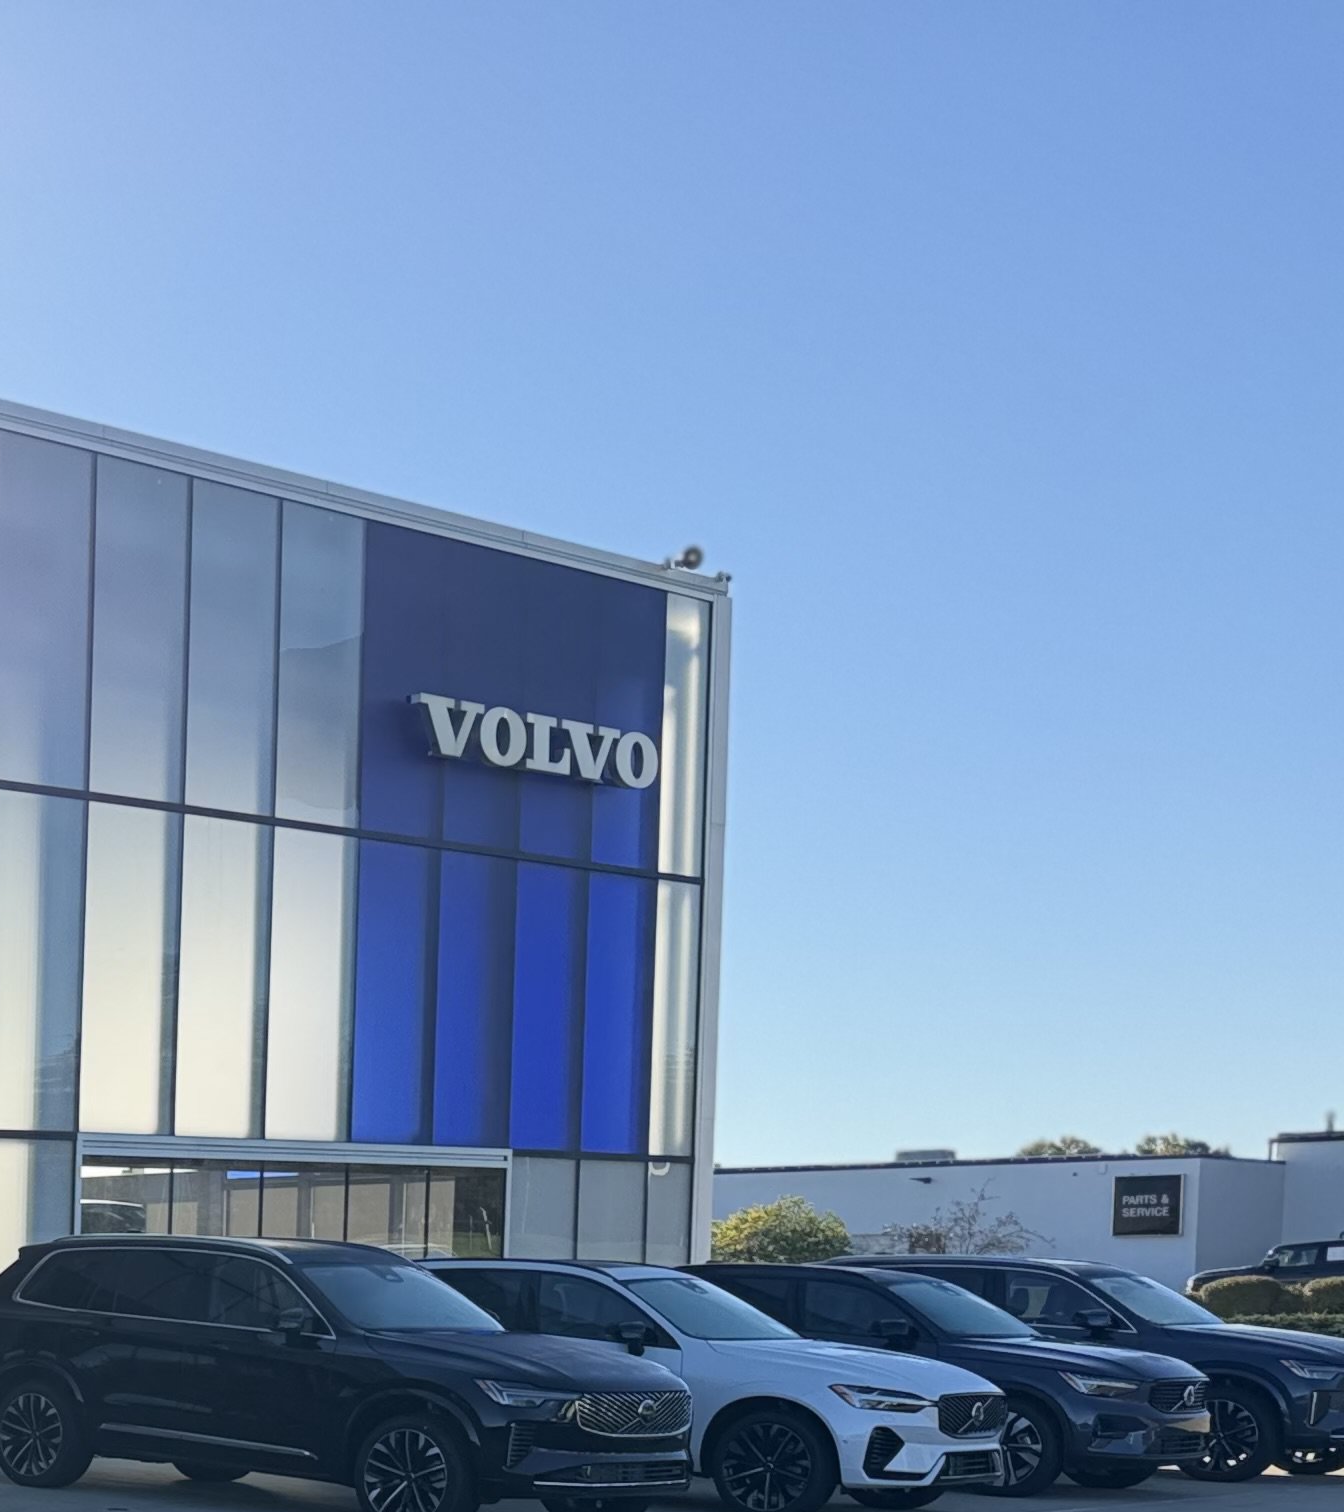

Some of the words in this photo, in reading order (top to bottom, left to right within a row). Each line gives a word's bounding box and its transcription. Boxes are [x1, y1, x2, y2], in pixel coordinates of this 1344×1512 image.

[411, 692, 659, 789] VOLVO
[1122, 1194, 1157, 1205] PARTS
[1160, 1193, 1170, 1204] &
[1121, 1206, 1170, 1218] SERVICE
